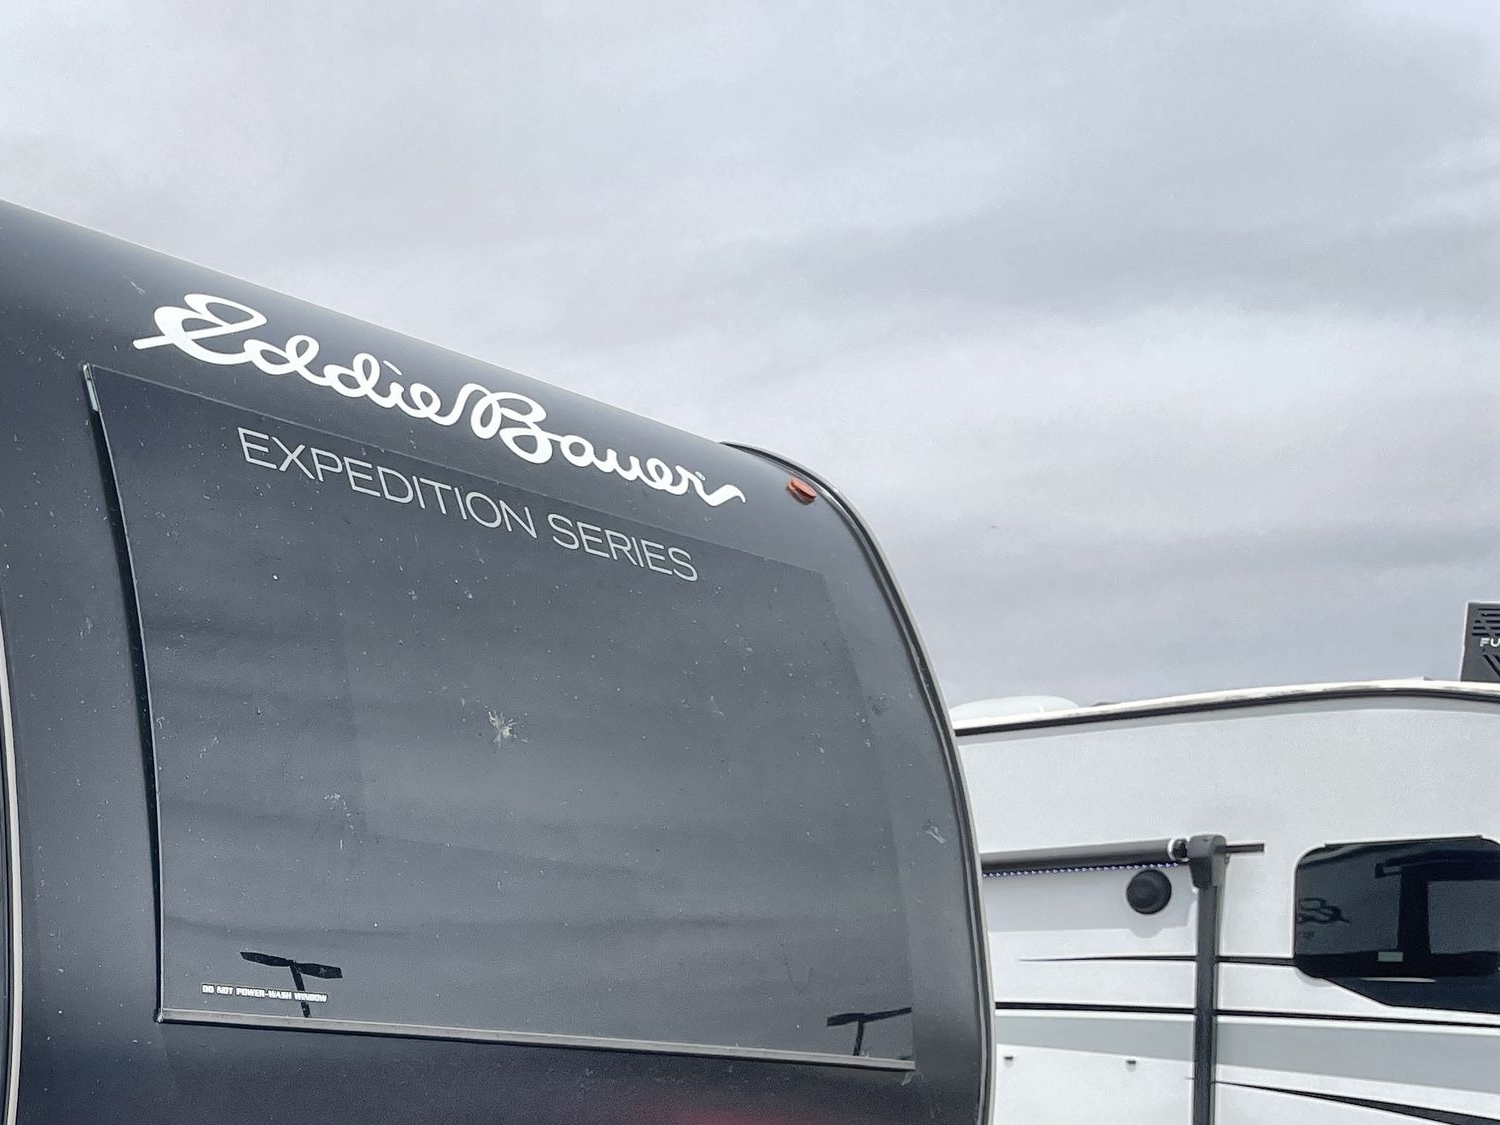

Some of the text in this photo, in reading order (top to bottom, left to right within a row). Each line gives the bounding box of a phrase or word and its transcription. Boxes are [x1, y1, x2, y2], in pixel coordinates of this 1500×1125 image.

[133, 293, 745, 507] Eddie Bauer
[238, 426, 698, 583] EXPEDITION SERIES
[202, 984, 214, 993] DO
[216, 986, 233, 995] NOT
[236, 987, 292, 999] POWER-WASH
